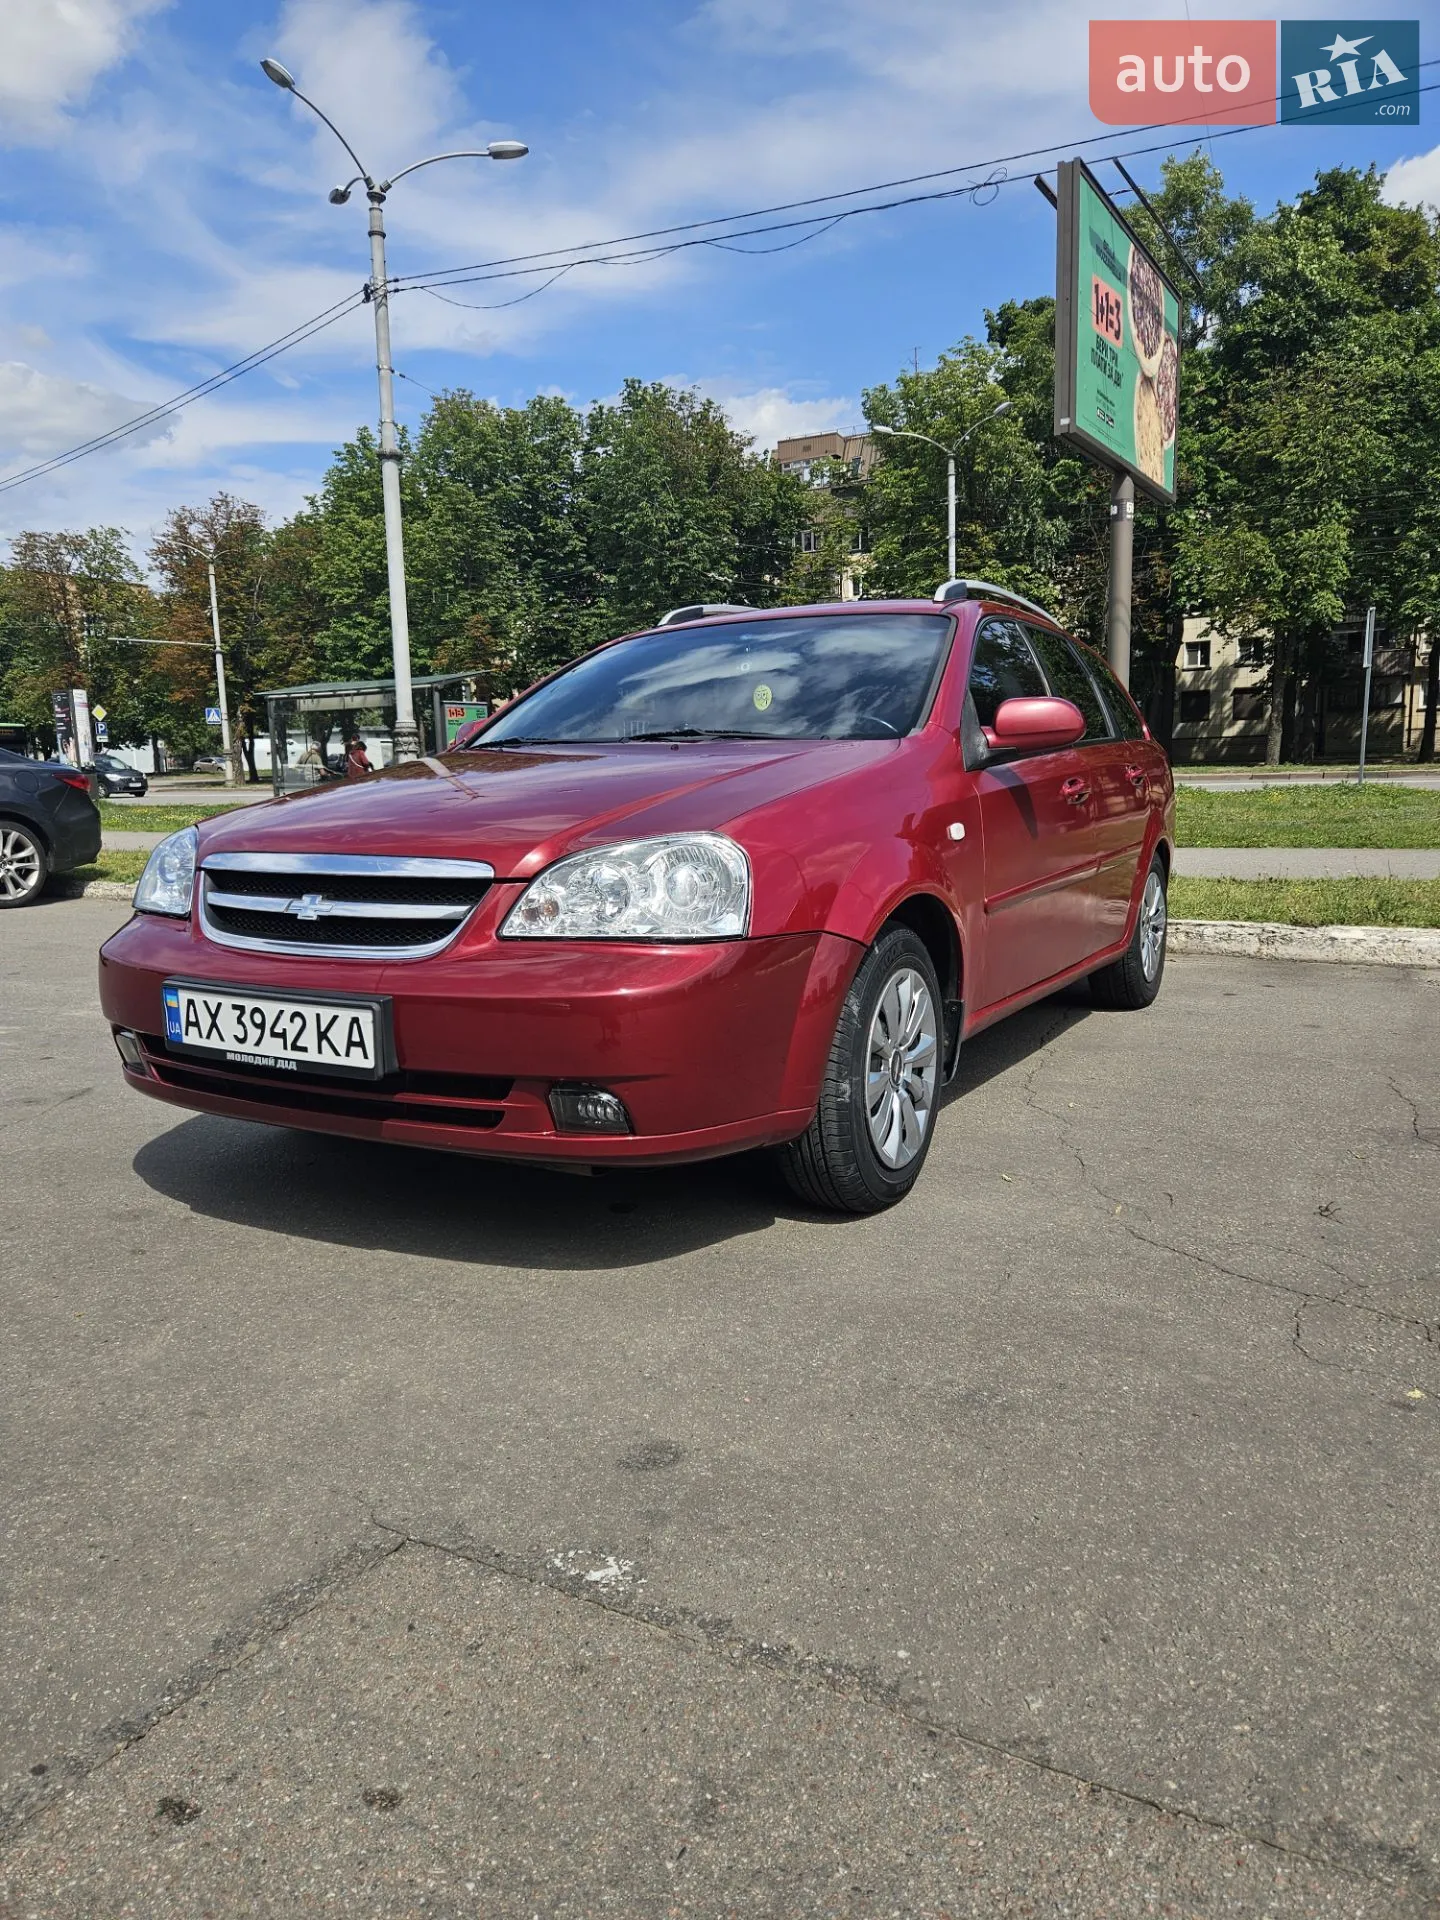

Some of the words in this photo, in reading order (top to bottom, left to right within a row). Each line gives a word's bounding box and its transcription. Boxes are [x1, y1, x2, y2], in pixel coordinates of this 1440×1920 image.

[1094, 283, 1120, 340] 1+1=3
[98, 723, 106, 734] P
[169, 1021, 181, 1035] UA
[226, 1052, 275, 1066] МОЛОДИЙ
[276, 1059, 297, 1071] ДІД
